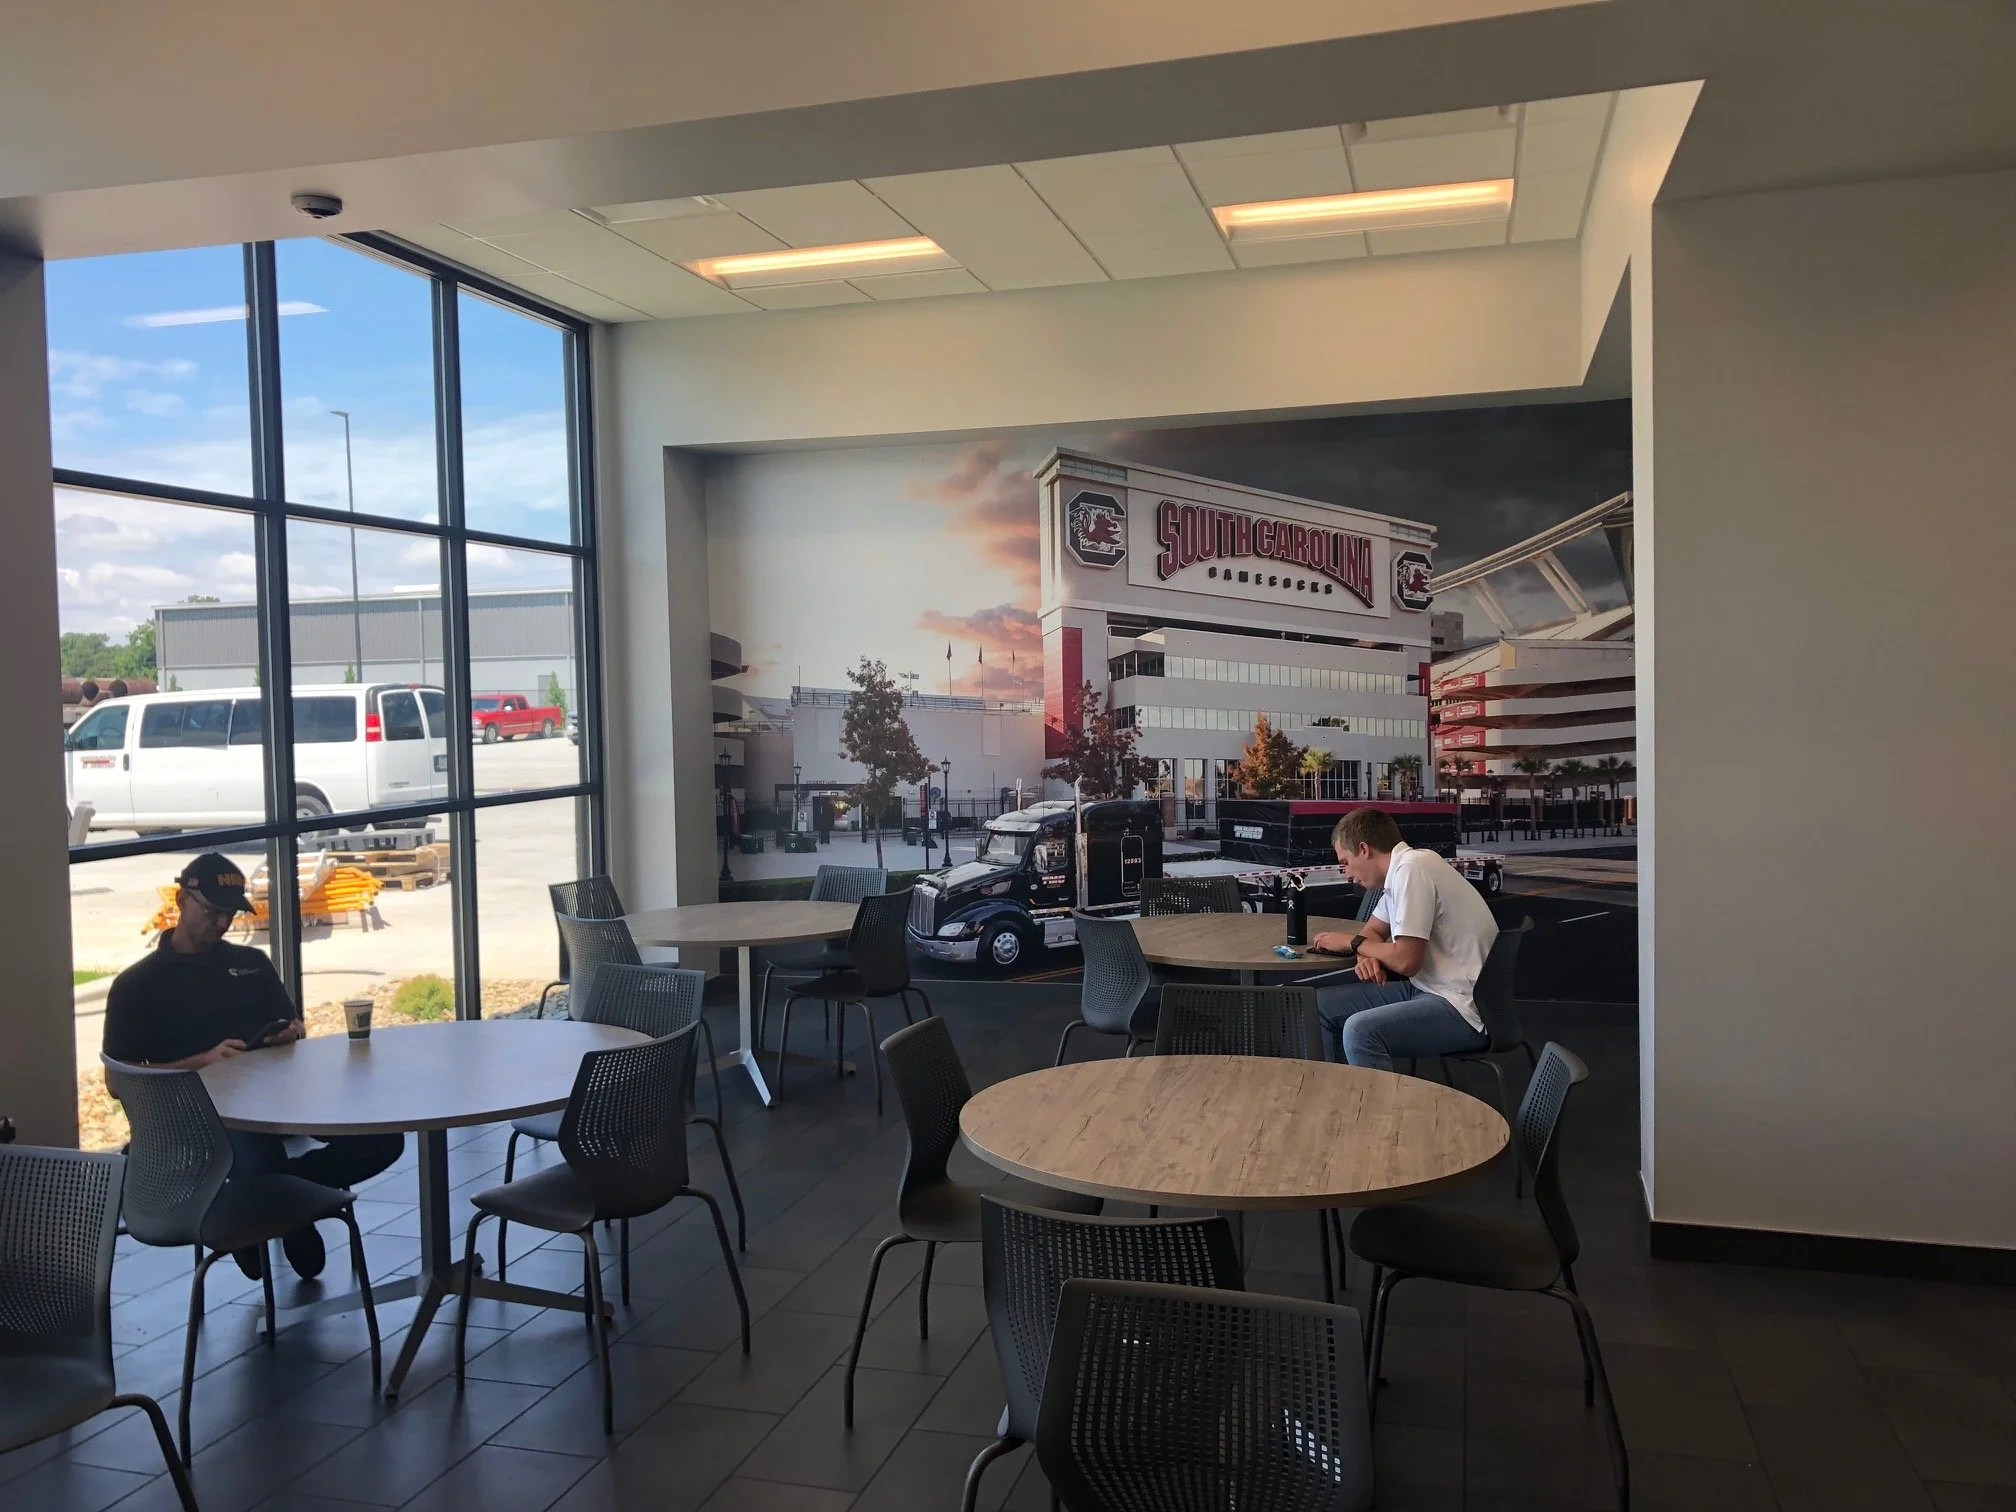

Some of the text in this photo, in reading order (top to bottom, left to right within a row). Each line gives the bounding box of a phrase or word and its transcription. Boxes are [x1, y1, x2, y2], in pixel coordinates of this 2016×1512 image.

[1157, 500, 1374, 608] SOUTH CAROLINA
[1208, 566, 1332, 595] GAMECOCKS
